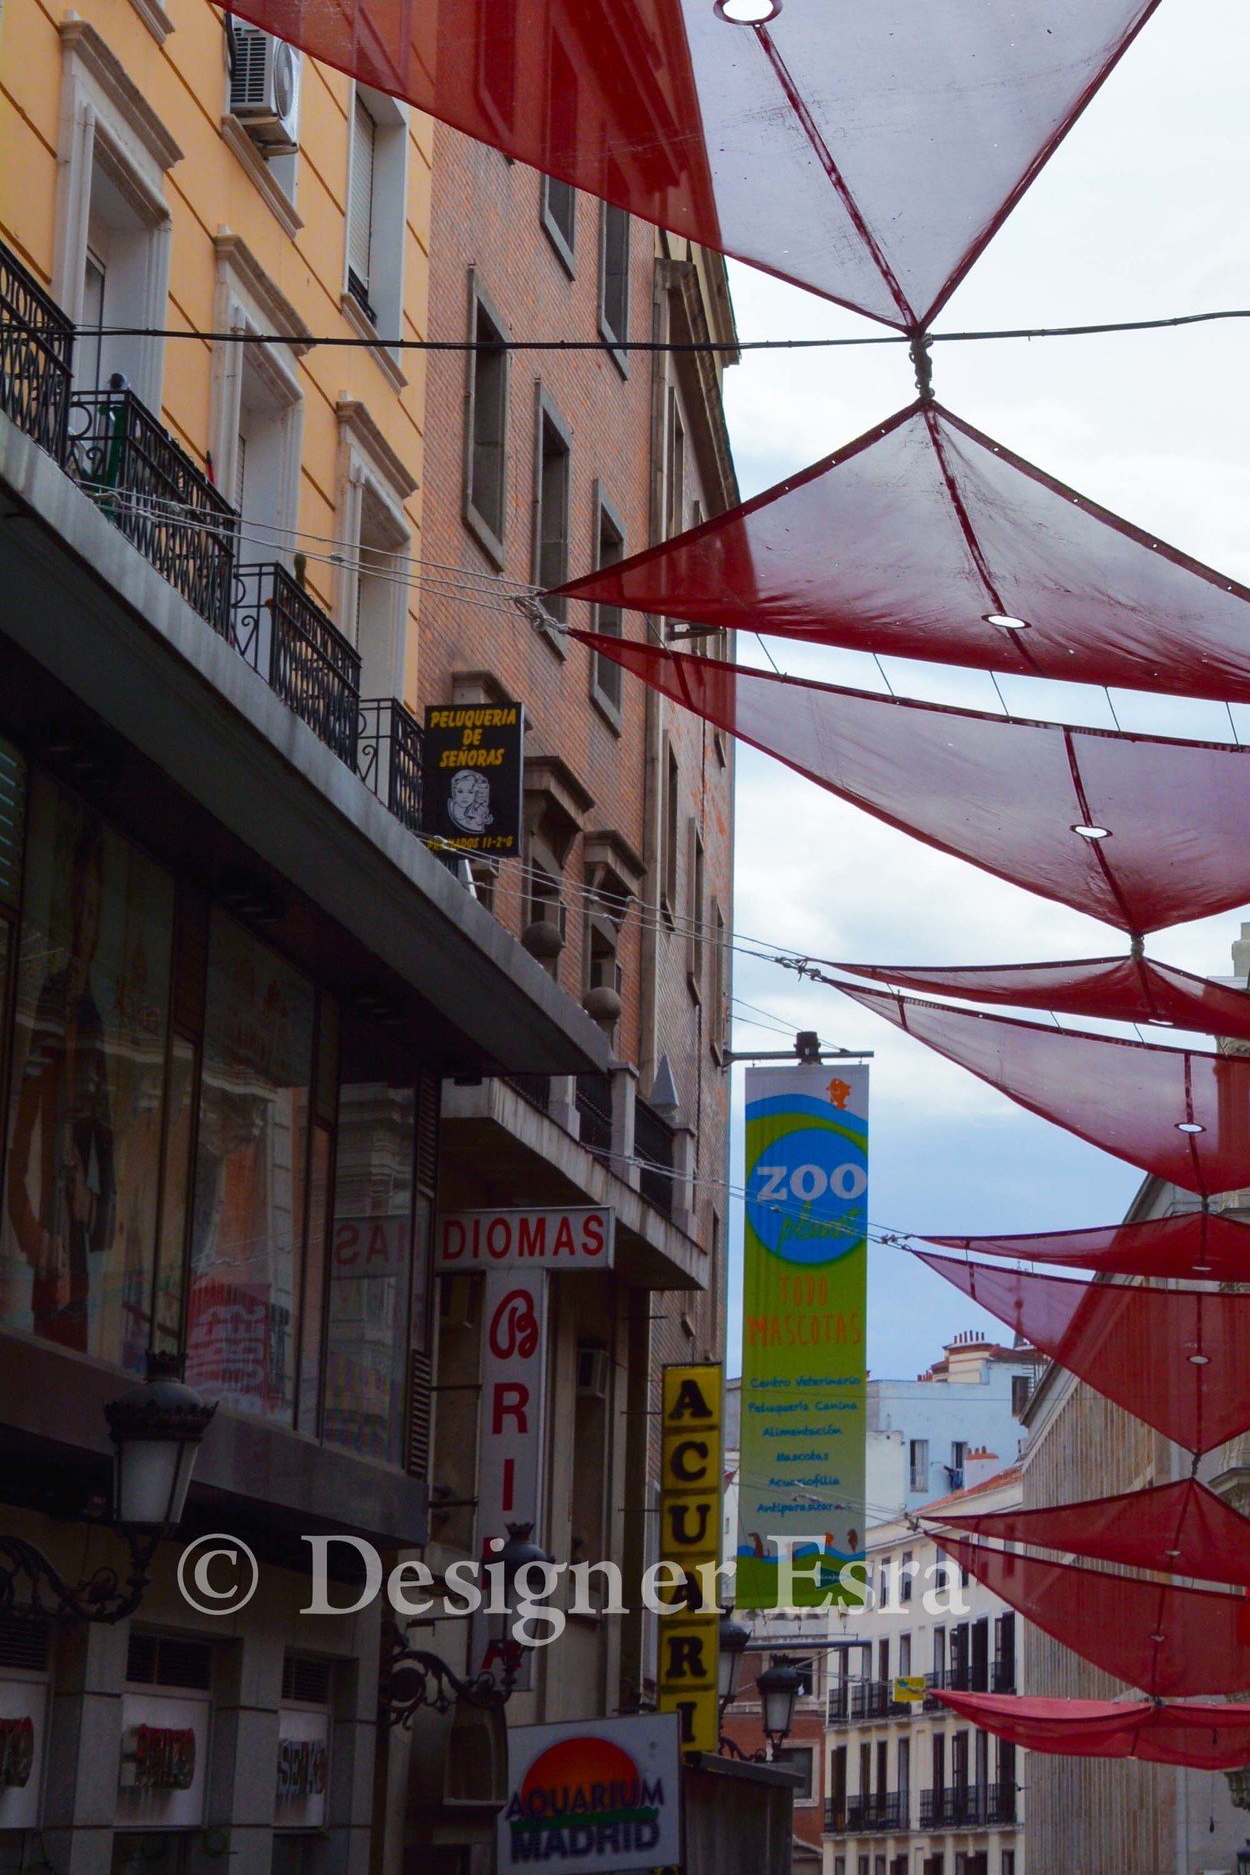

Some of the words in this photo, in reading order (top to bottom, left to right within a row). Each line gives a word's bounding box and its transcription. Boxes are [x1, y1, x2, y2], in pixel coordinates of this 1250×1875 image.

[429, 707, 518, 729] PELUQUERIA
[461, 728, 484, 746] DE
[438, 746, 506, 769] SEÑORAS
[756, 1163, 868, 1202] ZOO
[442, 1212, 606, 1261] DIOMAS
[776, 1199, 865, 1254] planet
[779, 1274, 829, 1307] TODO
[746, 1311, 862, 1348] MASCOTAS
[750, 1376, 792, 1388] Centro
[795, 1375, 862, 1388] Veterinario
[747, 1400, 810, 1417] Peluquería
[814, 1401, 859, 1411] Canina
[762, 1424, 844, 1437] Alimentación
[776, 1451, 830, 1463] Mascotas
[505, 1777, 665, 1822] AQUARIUM
[510, 1821, 660, 1863] MADRID
